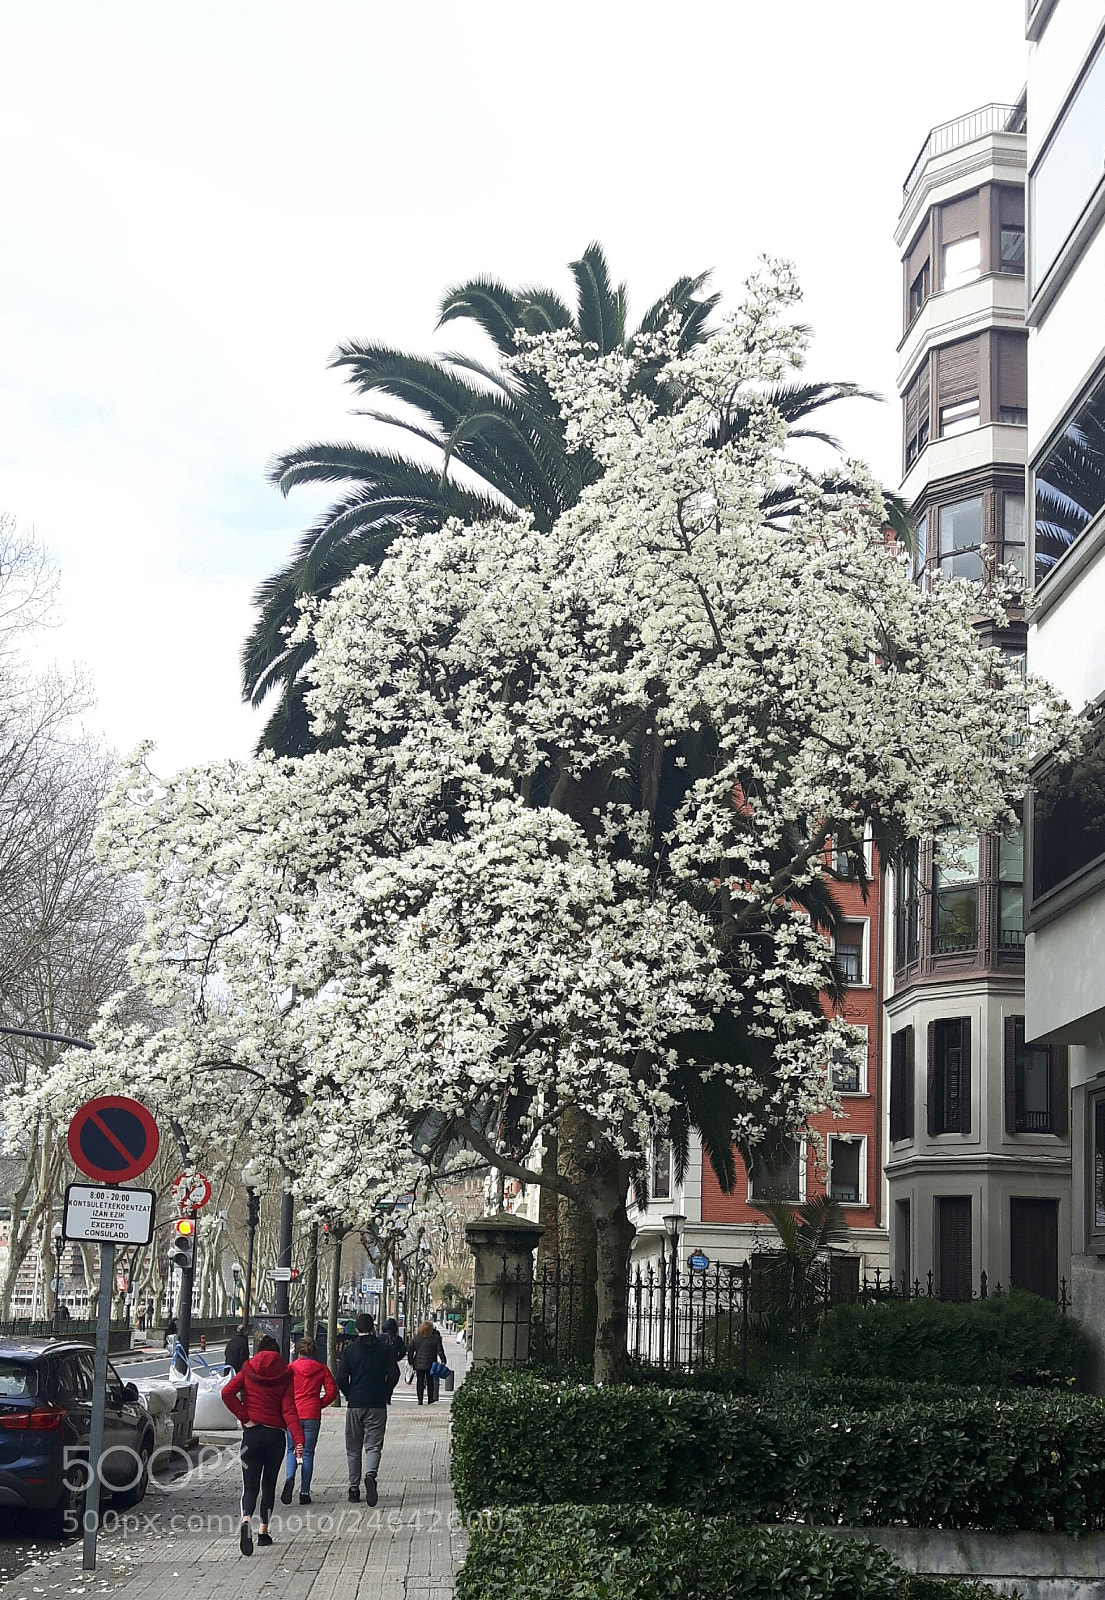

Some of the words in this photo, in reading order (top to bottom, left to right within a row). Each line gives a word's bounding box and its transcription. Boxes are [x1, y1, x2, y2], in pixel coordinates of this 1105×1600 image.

[89, 1191, 105, 1200] 8:00
[111, 1192, 130, 1202] 20:00
[68, 1199, 151, 1212] KONTSULETXEKOENTZAT
[92, 1210, 108, 1218] IZAN
[109, 1211, 125, 1219] EZIK
[91, 1221, 125, 1230] EXCEPTO
[84, 1229, 129, 1239] CONSULADO
